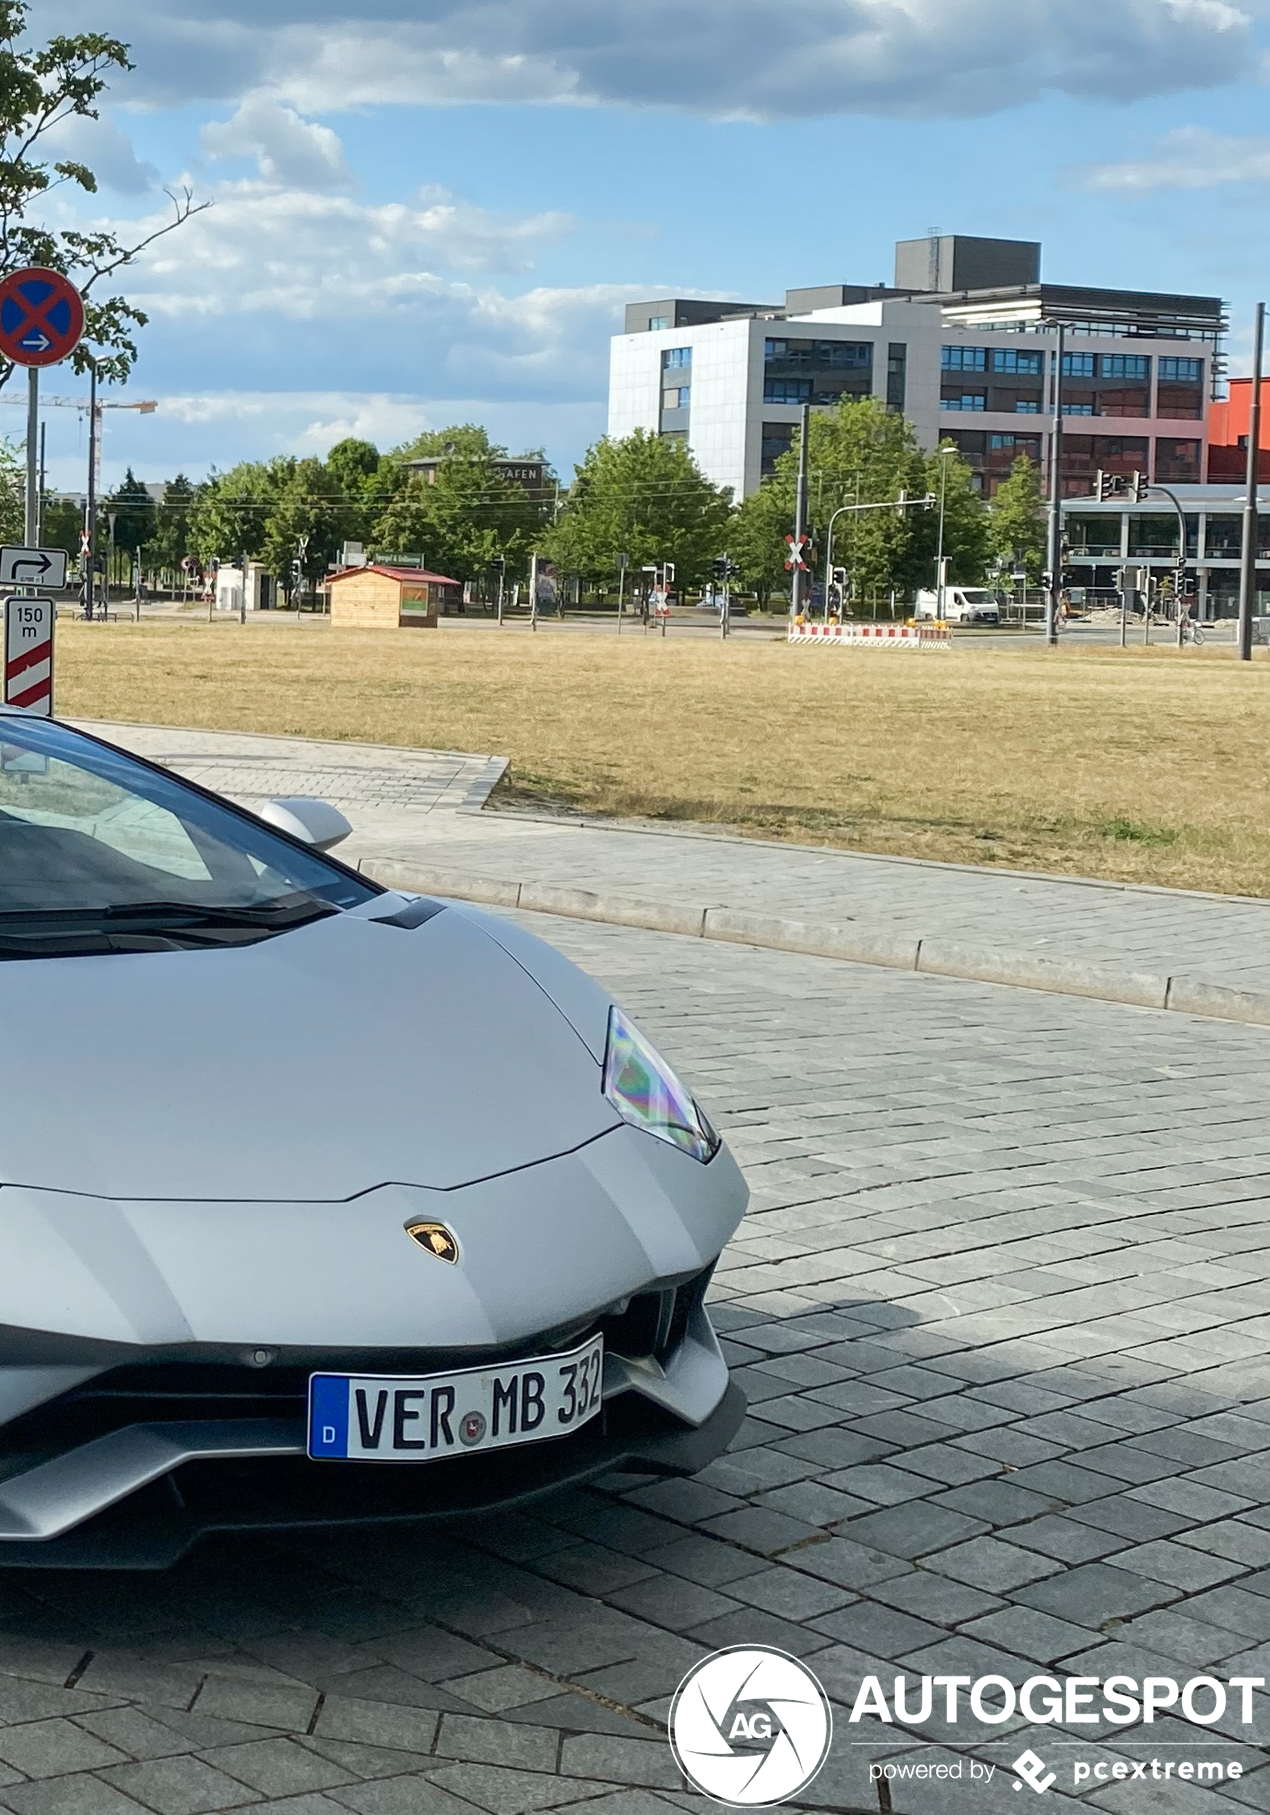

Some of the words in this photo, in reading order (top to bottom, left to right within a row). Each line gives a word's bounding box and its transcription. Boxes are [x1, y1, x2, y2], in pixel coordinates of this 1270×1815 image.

[17, 607, 43, 623] 150
[22, 626, 37, 638] m
[355, 1386, 456, 1449] VER
[491, 1372, 545, 1437] MB
[557, 1348, 601, 1424] 332
[322, 1425, 335, 1443] D
